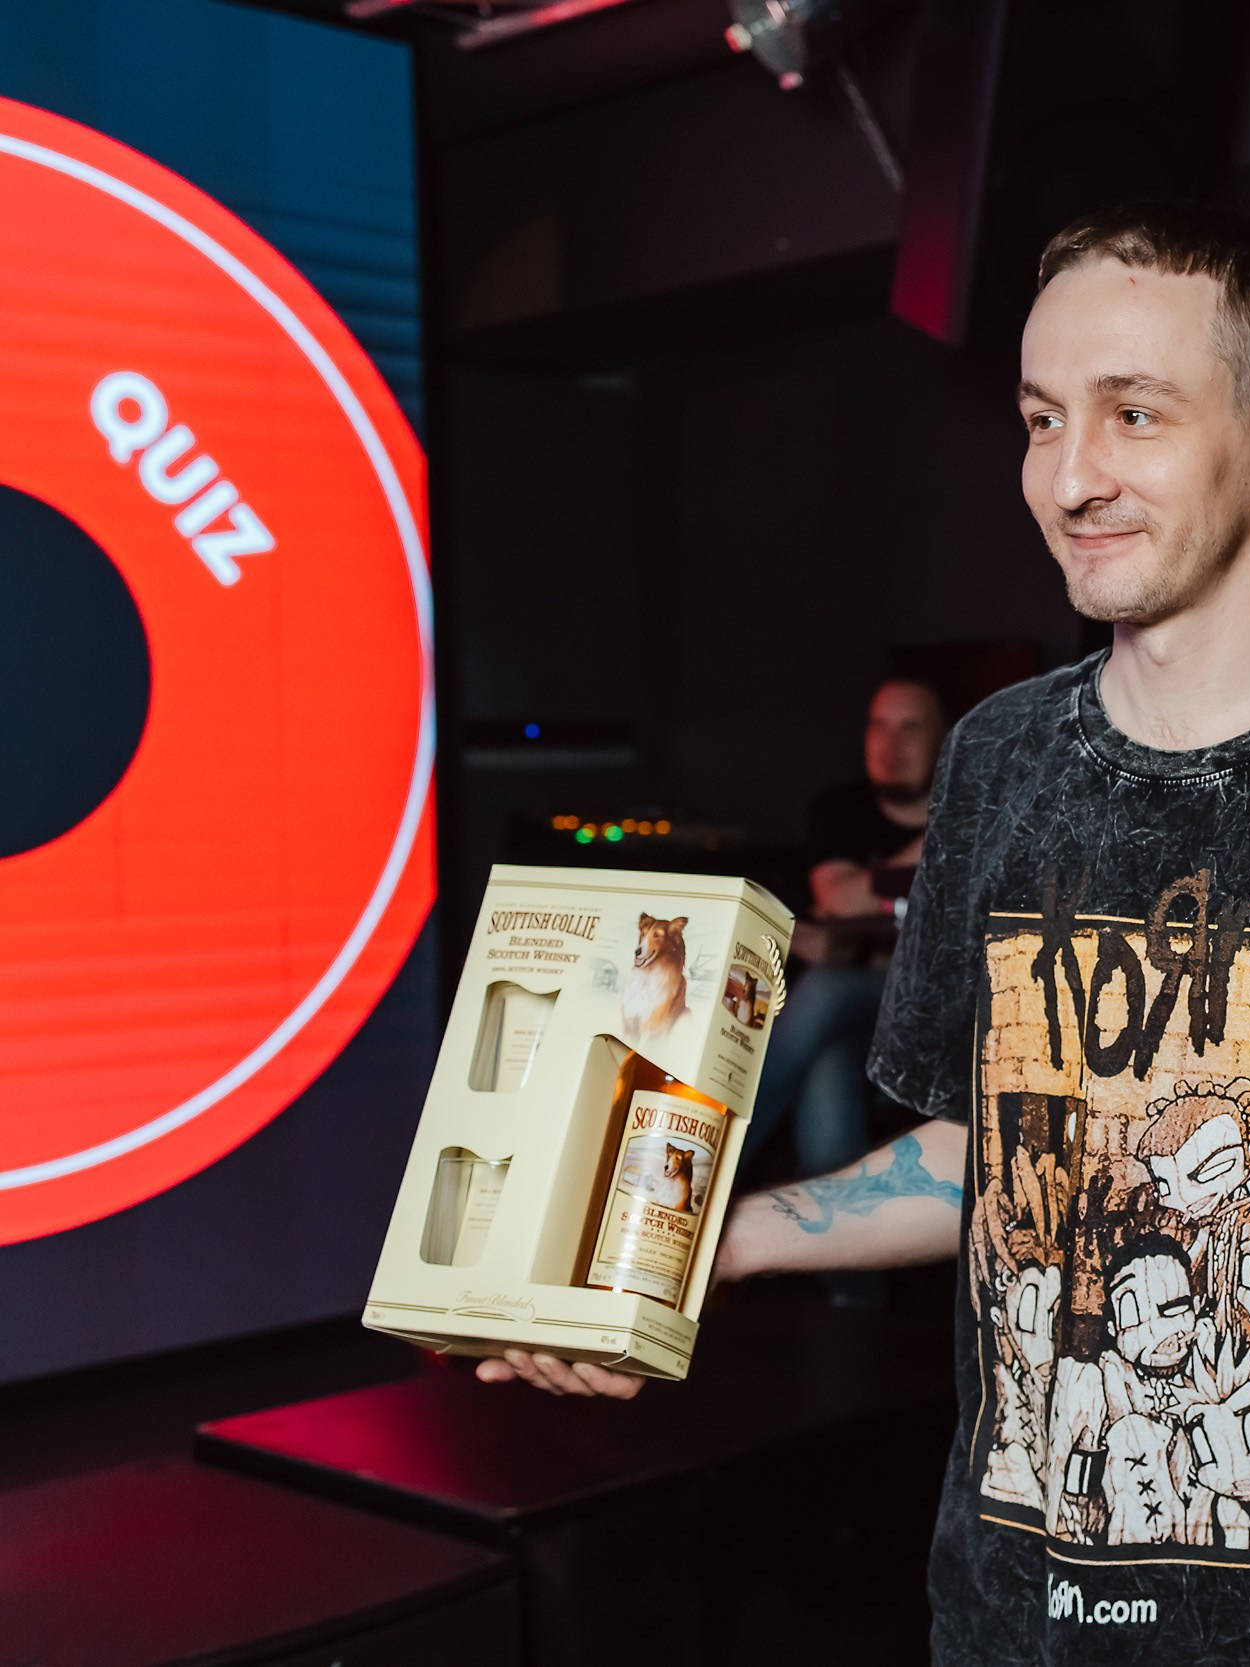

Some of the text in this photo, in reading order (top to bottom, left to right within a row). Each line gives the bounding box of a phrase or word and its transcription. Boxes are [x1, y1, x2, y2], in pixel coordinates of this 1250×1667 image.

[90, 371, 276, 586] QUIZ
[487, 911, 600, 941] SCOTTISH COLLIE
[632, 1106, 699, 1137] SCOTTISH
[621, 1211, 665, 1229] STCH
